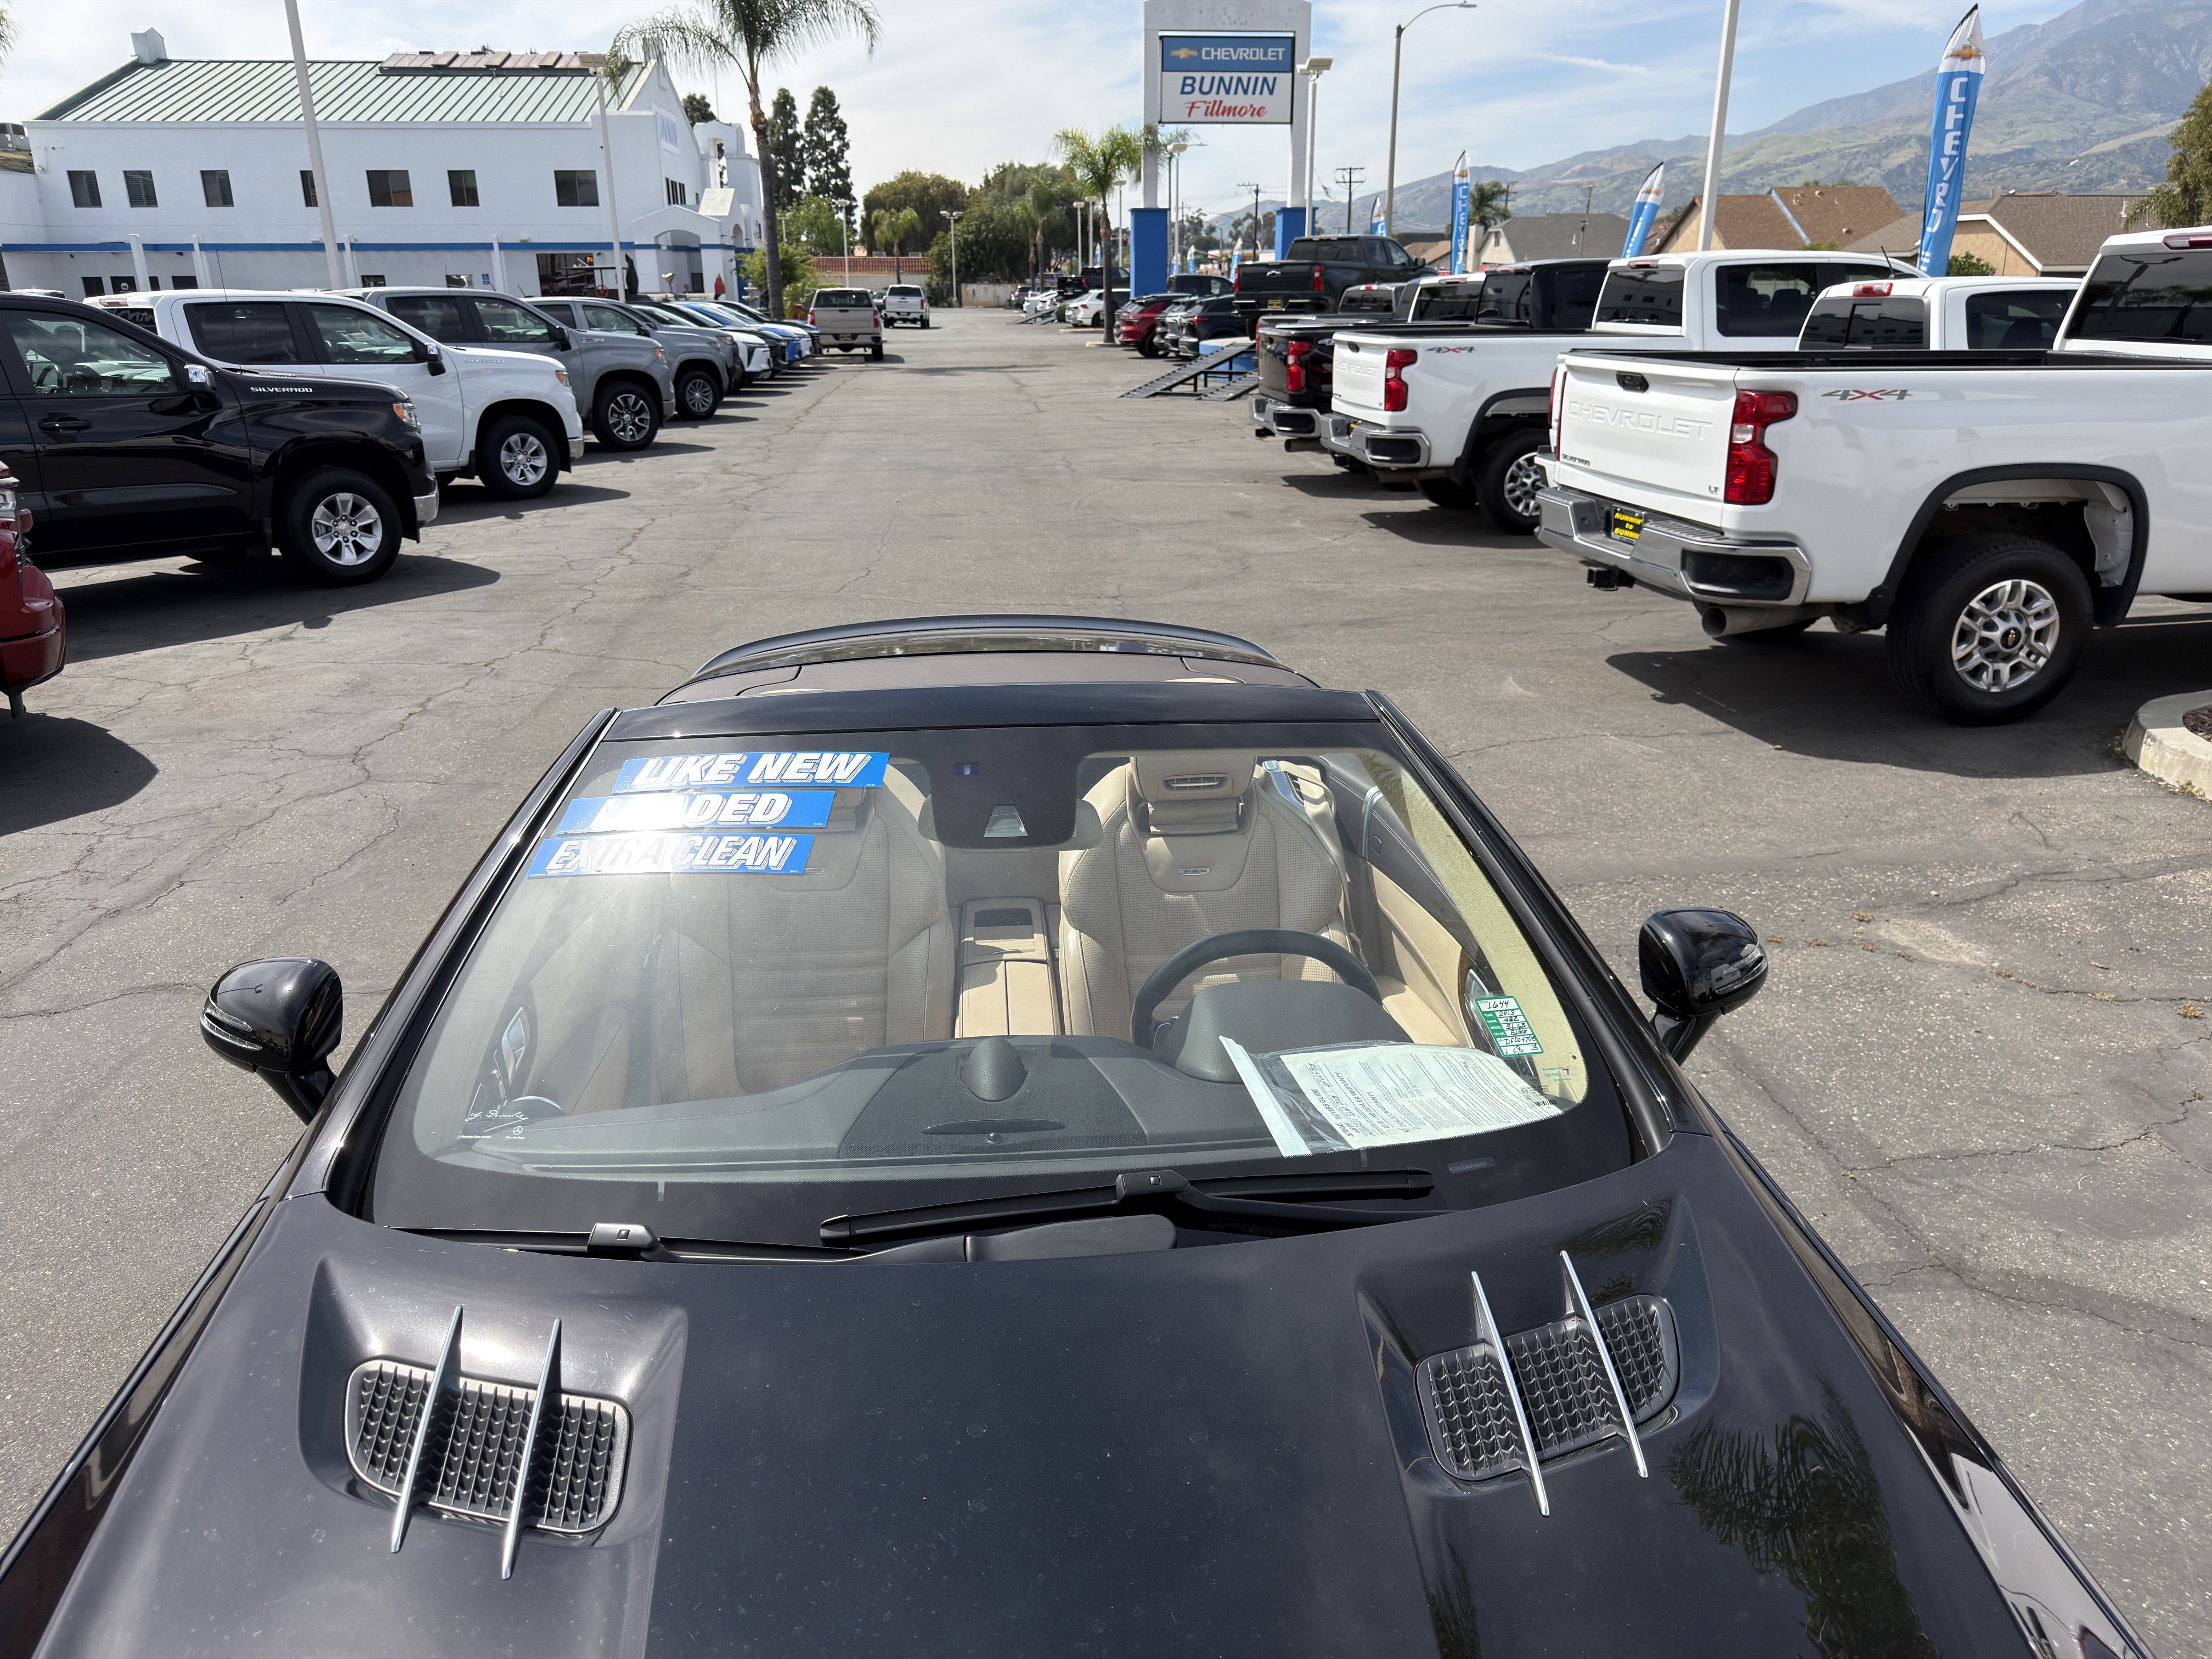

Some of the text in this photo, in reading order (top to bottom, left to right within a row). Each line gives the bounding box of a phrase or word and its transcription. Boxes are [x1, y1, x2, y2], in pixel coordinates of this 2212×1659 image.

[1201, 47, 1285, 60] CHEVROLET
[1180, 76, 1277, 95] BUNNIN
[1184, 100, 1267, 118] Fillmore
[1567, 400, 1714, 441] CHEVROLET
[631, 753, 872, 786] LIKE NEW
[589, 793, 792, 827] LDED
[670, 836, 798, 871] CLEAN
[1487, 1000, 1509, 1009] 1644
[1333, 1071, 1358, 1096] WARRANTY
[1310, 1088, 1342, 1119] BUYERS GUIDE
[1352, 1096, 1372, 1112] DEALER
[1365, 1091, 1407, 1127] DEALER WARRANTY
